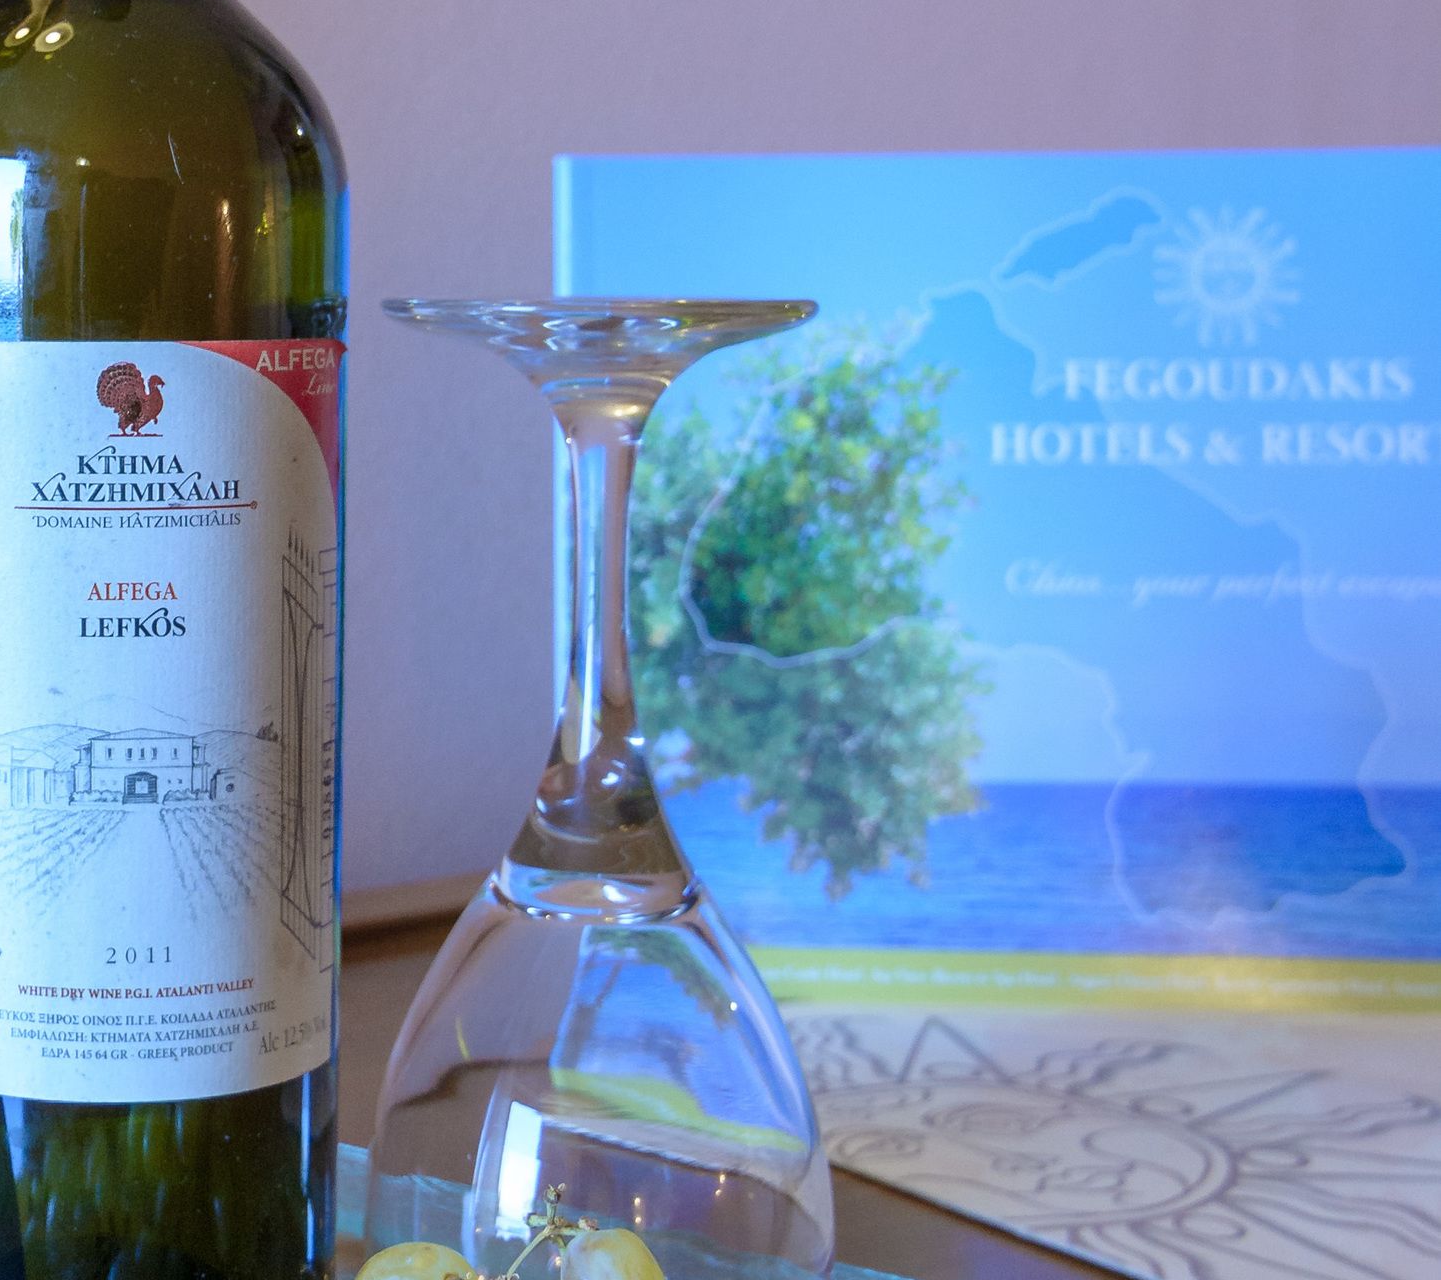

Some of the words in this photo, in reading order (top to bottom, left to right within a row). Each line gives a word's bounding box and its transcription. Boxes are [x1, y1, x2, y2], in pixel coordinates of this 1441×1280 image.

[255, 347, 336, 372] ALFEGA
[1064, 358, 1414, 401] FEGOUDAKIS
[990, 422, 1193, 466] HOTELS
[1202, 430, 1243, 466] &
[76, 445, 185, 475] ΚΤΗΜΑ
[31, 472, 241, 503] ΧΑΤΖΗΜΙΧΑΛΗ
[32, 514, 113, 529] DOMAINE
[119, 509, 242, 529] HATZIMICHALIS
[87, 581, 179, 601] ALFEGA
[79, 607, 187, 638] LEFKOS
[105, 945, 174, 965] 2011
[18, 984, 58, 998] WHITE
[60, 987, 85, 1000] DRY
[88, 988, 122, 999] WINE
[124, 988, 153, 999] P.G.I.
[156, 983, 214, 998] ATALANTI
[217, 978, 255, 993] VALLEY
[38, 1012, 80, 1025] ΞΗΡΟΣ
[82, 1013, 123, 1026] ΟΙΝΟΣ
[160, 1010, 214, 1025] ΚΟΙΛΑΔΑ
[216, 999, 278, 1020] ΑΤΑΛΑΝΤΗΣ
[10, 1027, 88, 1043] ΕΜΦΙΑΛΩΣΗ:
[90, 1029, 151, 1043] ΚΤΗΜΑΤΑ
[154, 1023, 241, 1042] ΧΑΤΖΗΜΙΧΑΛΗ
[259, 1031, 280, 1055] Alc
[41, 1047, 71, 1059] ΕΔΡΑ
[74, 1048, 93, 1059] 145
[95, 1048, 108, 1059] 64
[110, 1048, 129, 1060] GR
[137, 1046, 178, 1060] GREEK
[179, 1041, 234, 1058] PRODUCT
